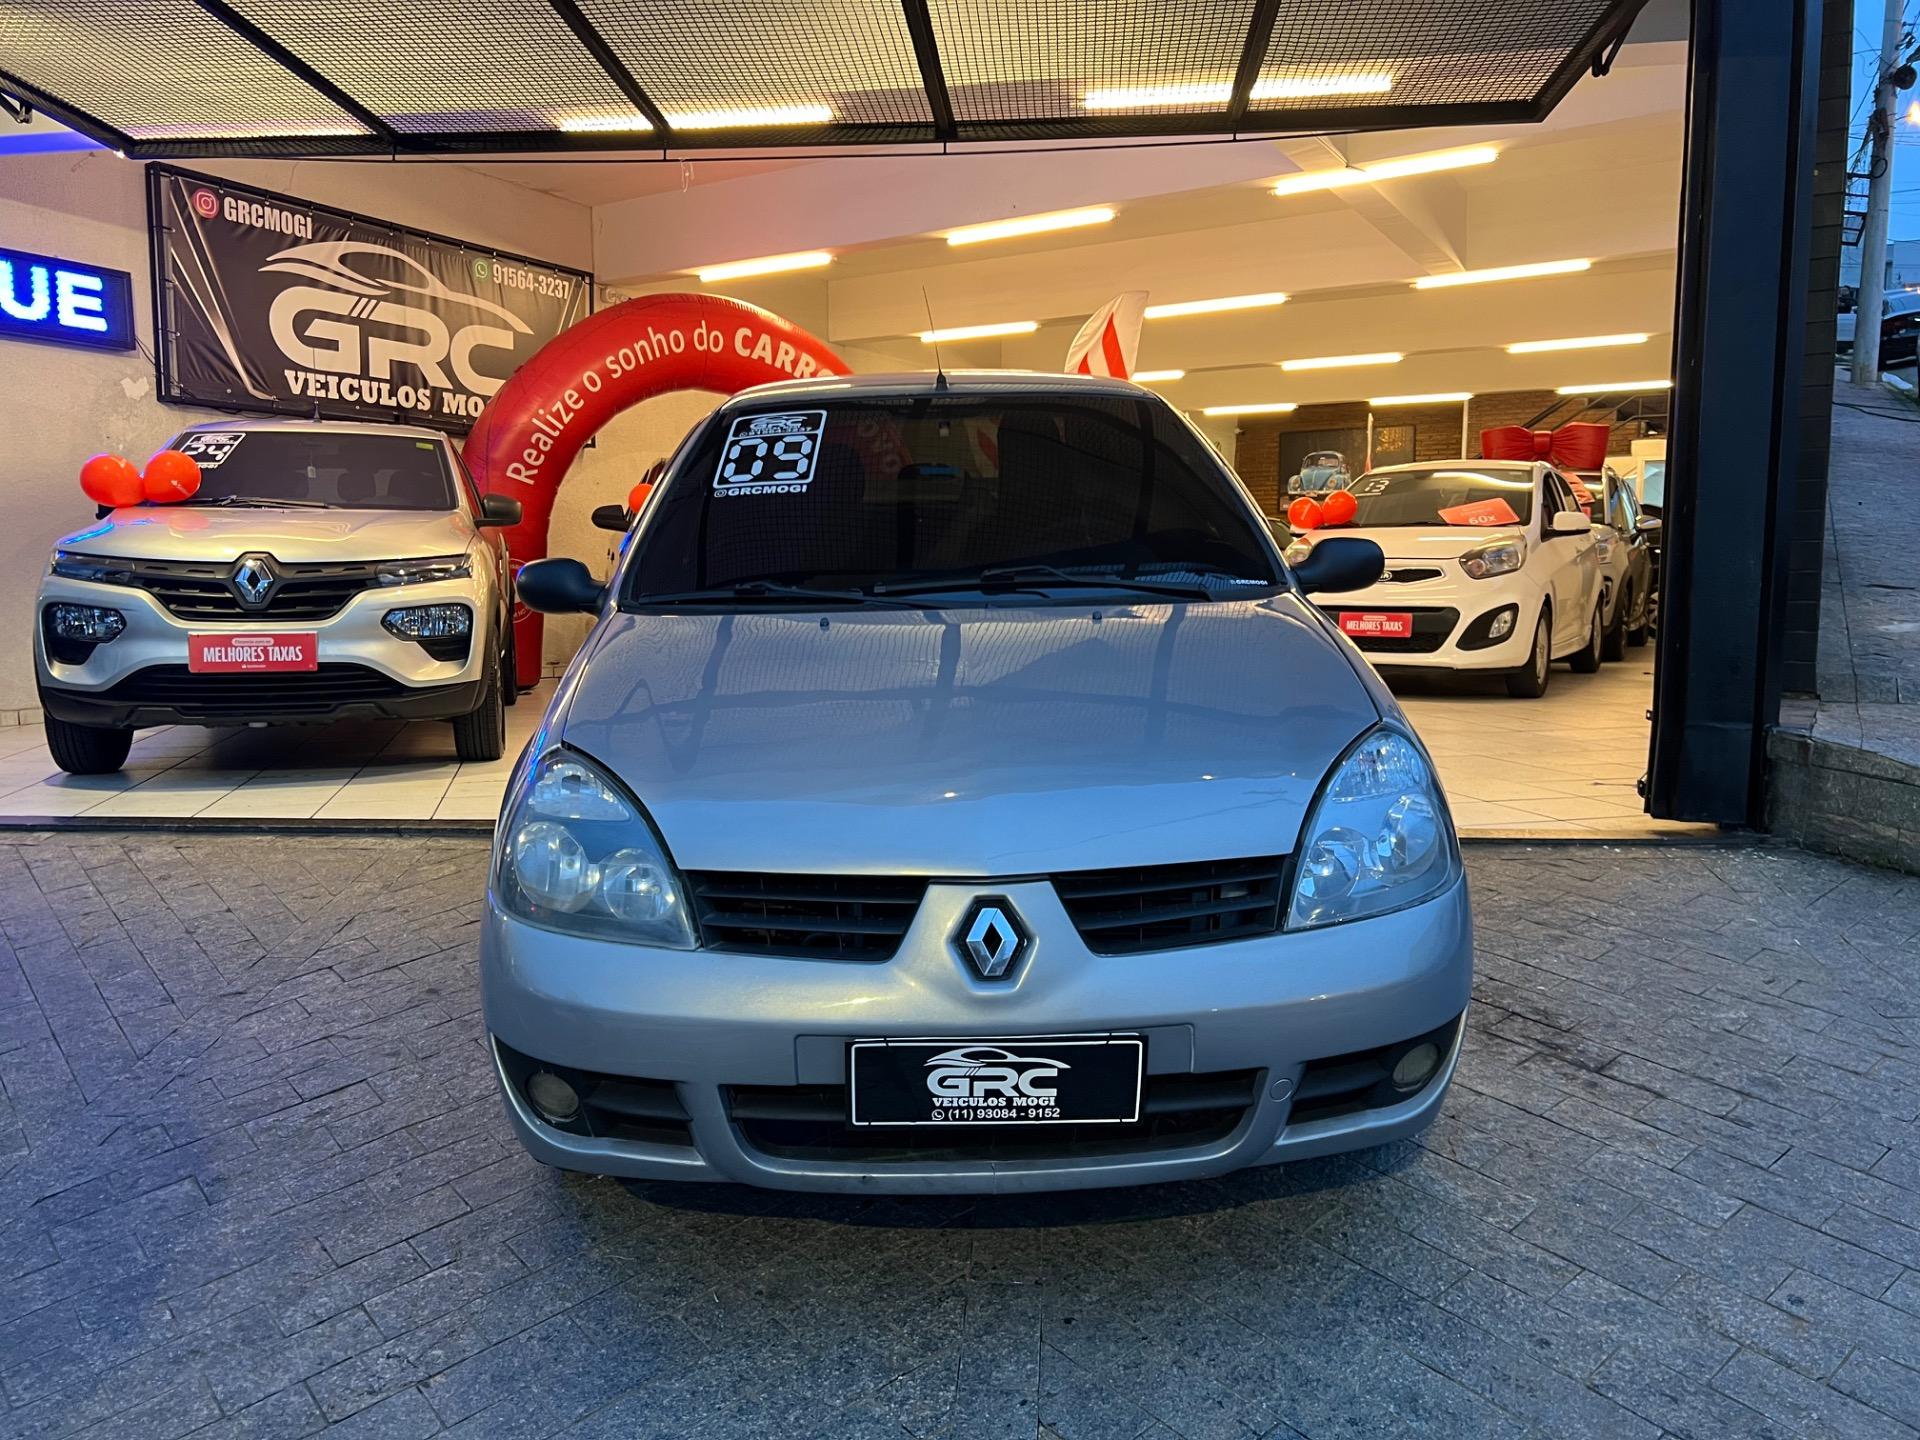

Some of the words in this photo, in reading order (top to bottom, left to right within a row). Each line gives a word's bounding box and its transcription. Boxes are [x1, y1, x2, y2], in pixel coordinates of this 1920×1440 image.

[223, 196, 313, 240] GRCMOGI
[0, 259, 108, 332] UE
[493, 263, 570, 300] 91564-3237
[269, 286, 514, 397] GRC
[284, 369, 431, 411] VEICULOS
[442, 392, 487, 418] MO
[506, 388, 585, 485] Realize
[582, 370, 602, 393] o
[605, 326, 685, 379] sonho
[693, 320, 724, 352] do
[734, 327, 835, 378] CARR
[723, 435, 812, 482] 09
[1468, 515, 1497, 525] 60x
[1346, 620, 1381, 631] MELHORES
[1382, 621, 1403, 632] TAXAS
[203, 646, 265, 663] MELHORES
[267, 646, 303, 662] TAXAS
[926, 1067, 1058, 1097] GRC
[932, 1097, 1007, 1108] VEICULOS
[1012, 1096, 1056, 1107] MOGI
[948, 1108, 974, 1121] (11)
[976, 1108, 1018, 1119] 93084
[1028, 1107, 1061, 1118] 9152
